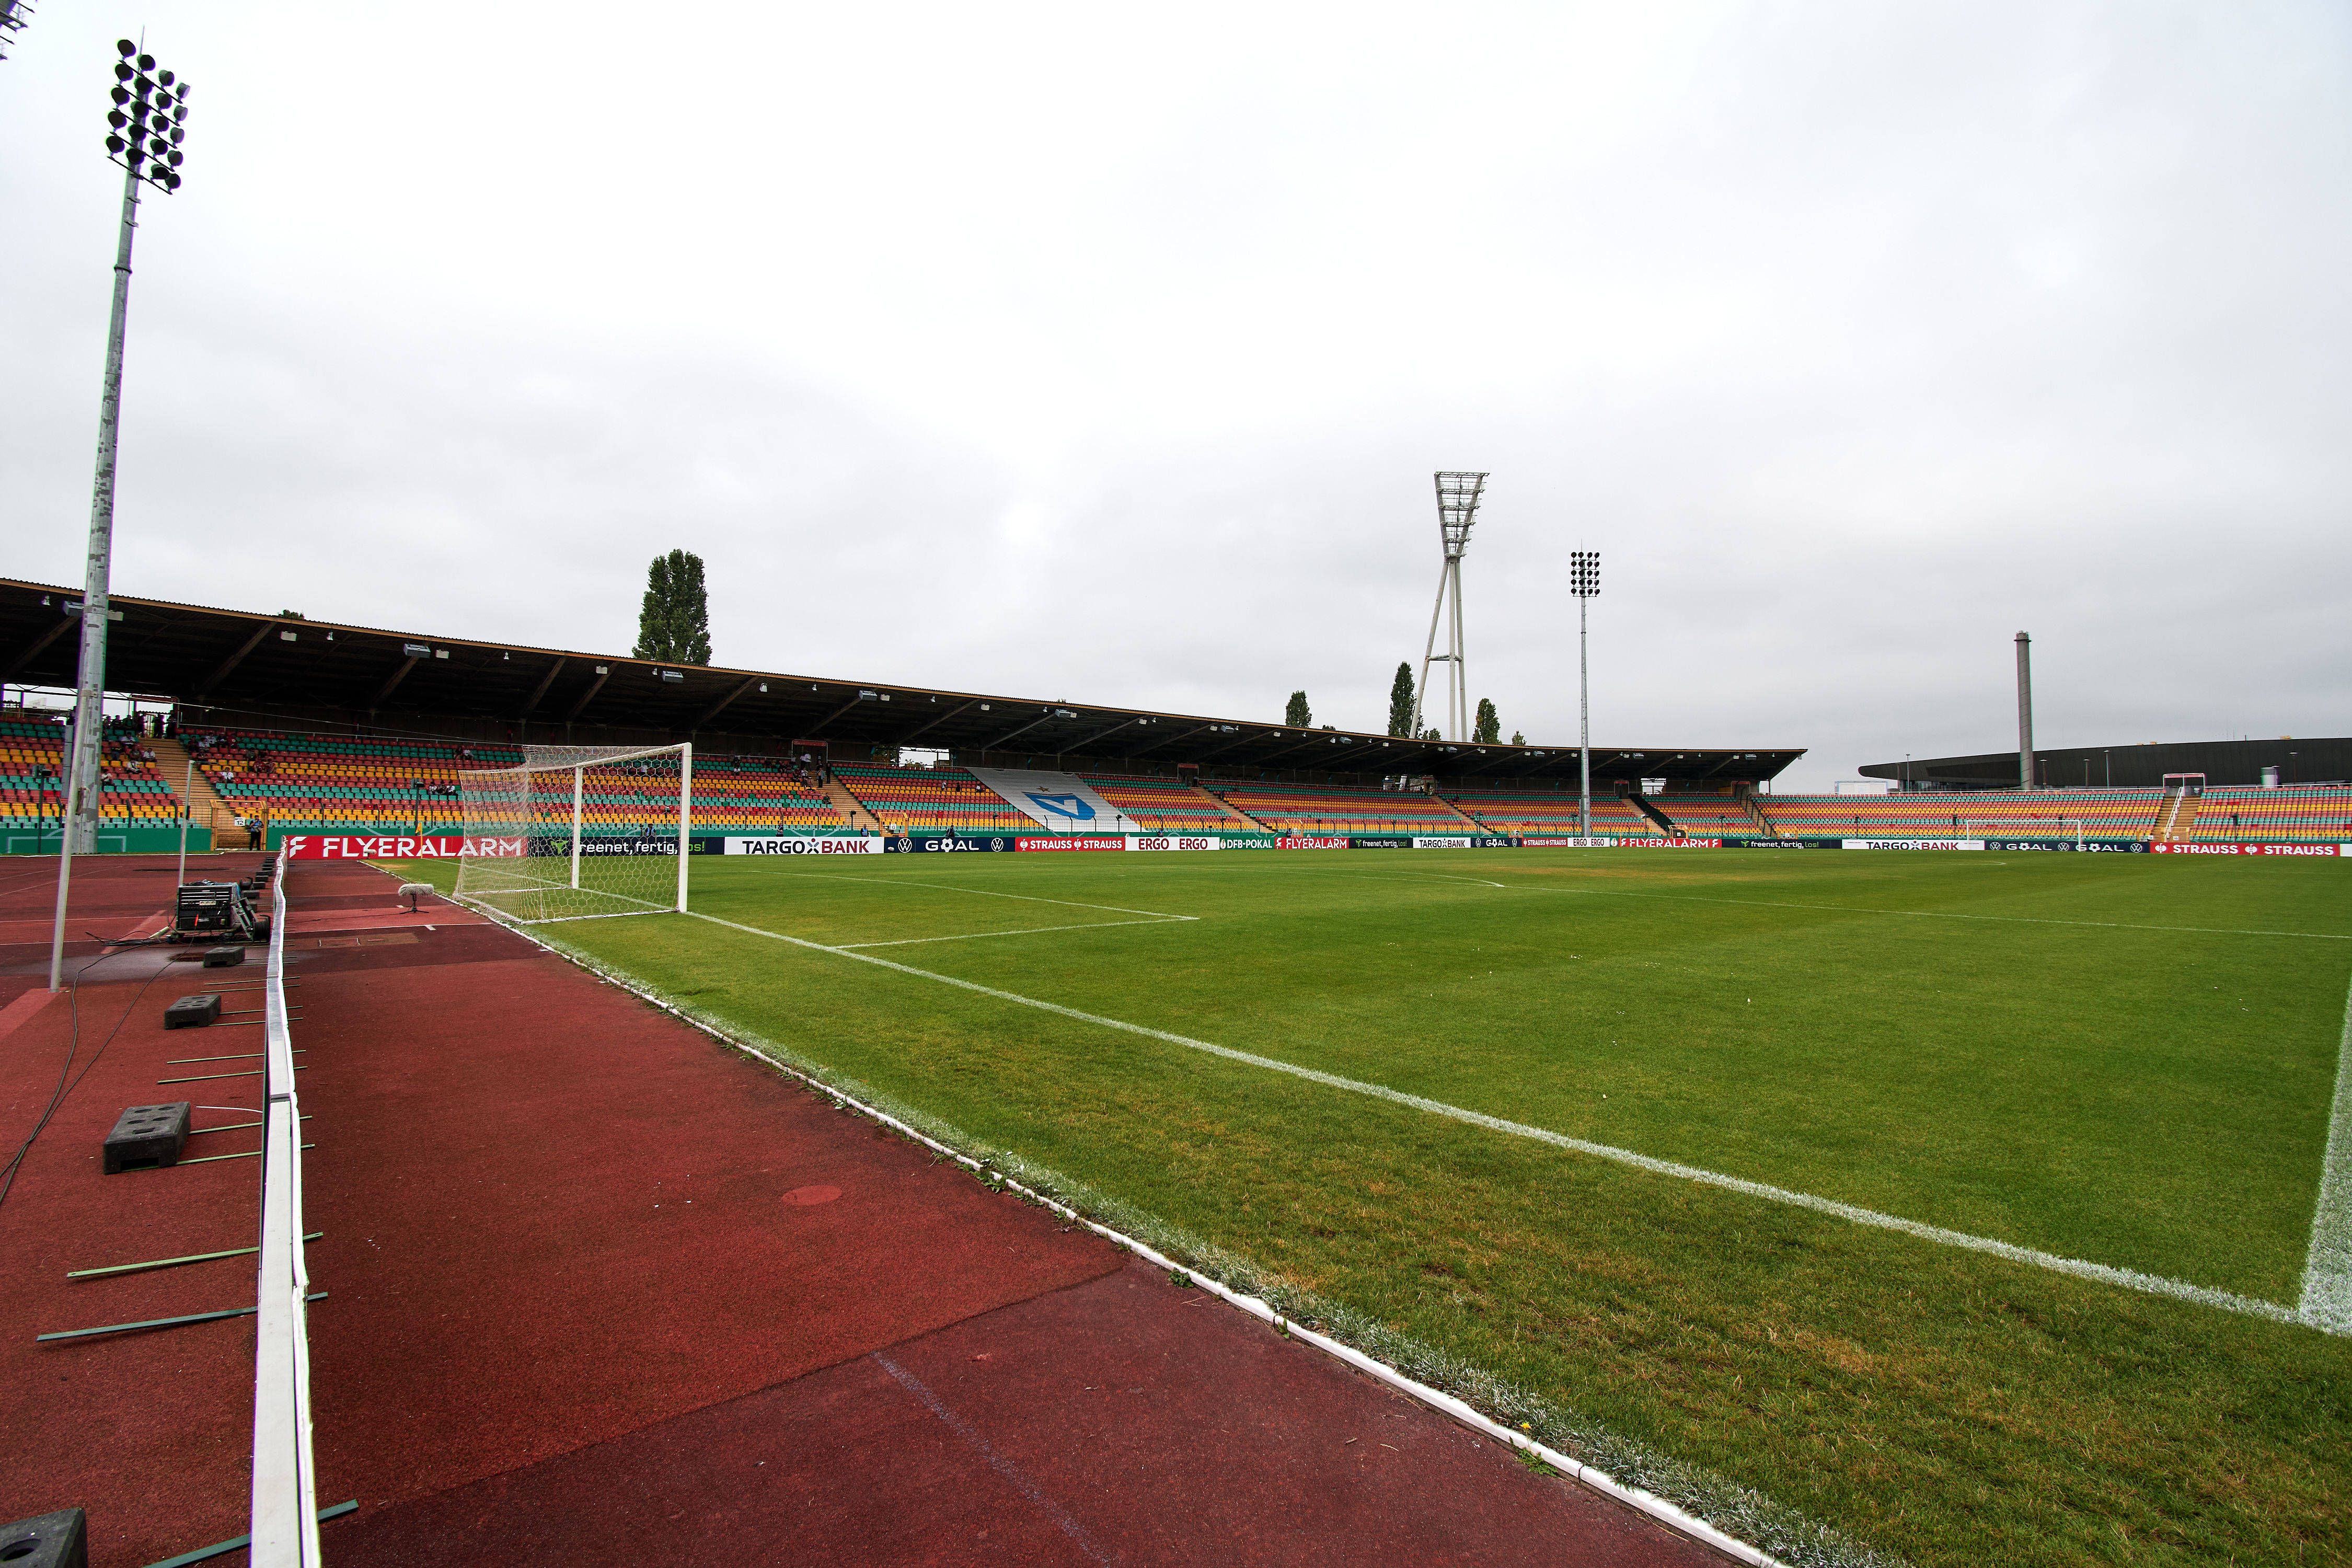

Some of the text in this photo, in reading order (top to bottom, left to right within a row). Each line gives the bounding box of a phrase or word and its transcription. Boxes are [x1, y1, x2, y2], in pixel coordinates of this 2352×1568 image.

[323, 838, 522, 857] FLYERALARM
[580, 841, 705, 855] reenet, fertig, os!
[1030, 840, 1122, 849] STRAUSS STRAUSS
[1138, 838, 1208, 850] ERGO ERGO
[1227, 839, 1272, 849] DFB-POKAL
[1286, 838, 1347, 849] FLYERALARM
[1363, 840, 1383, 848] freenet,
[1383, 840, 1398, 848] fertig,
[1629, 838, 1708, 848] FLYERALARM
[2173, 845, 2334, 855] STRAUSS STRAUSS
